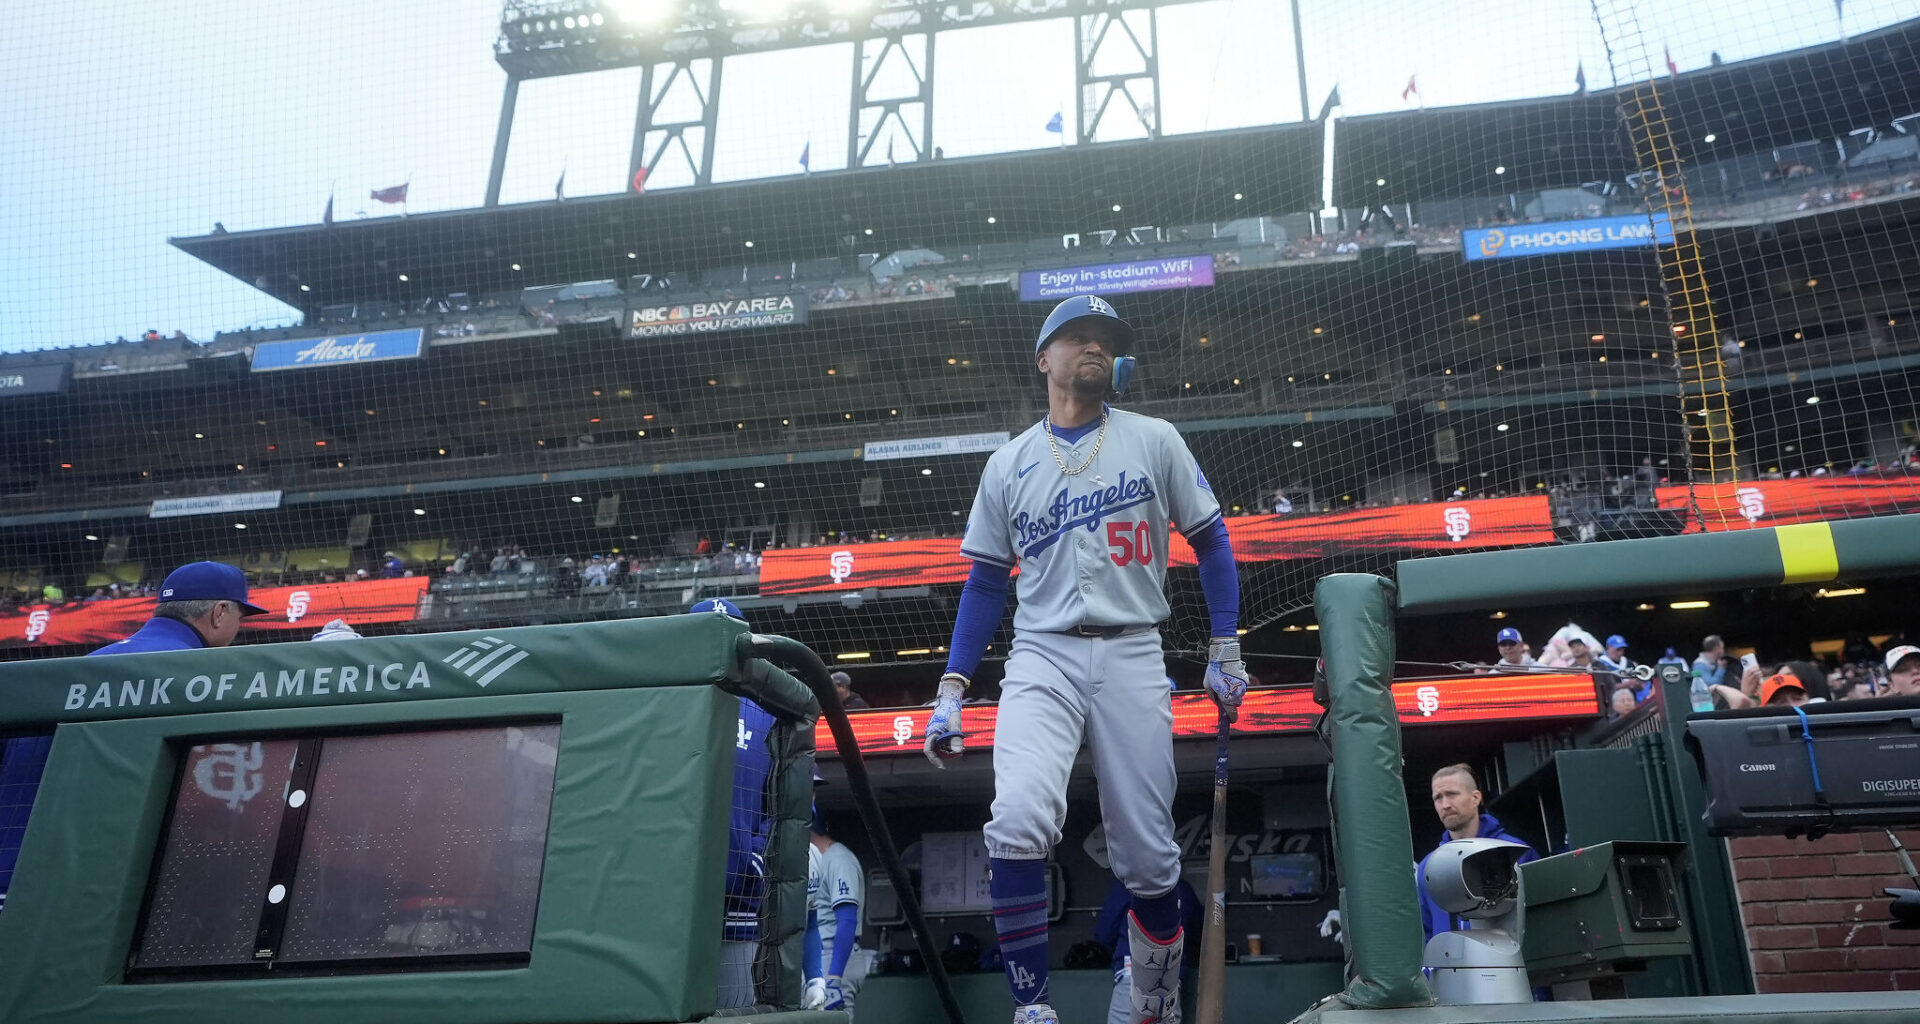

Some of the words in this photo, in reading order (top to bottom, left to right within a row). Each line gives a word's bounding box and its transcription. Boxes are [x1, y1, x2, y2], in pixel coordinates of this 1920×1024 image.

[1510, 228, 1604, 249] PHOONG
[1606, 224, 1652, 241] LAW
[1040, 272, 1078, 287] Enjoy
[1081, 265, 1159, 280] in-stadium
[1161, 260, 1193, 273] WiFi
[1040, 286, 1074, 296] Connect
[632, 307, 668, 323] NBC
[692, 301, 733, 318] BAY
[735, 296, 795, 313] AREA
[1087, 294, 1107, 314] LA
[631, 323, 686, 337] MOVING
[689, 320, 720, 332] YOU
[721, 314, 795, 329] FORWARD
[295, 337, 377, 362] Alaska
[1013, 511, 1050, 548] Los
[1049, 470, 1152, 532] Angeles
[1107, 520, 1153, 567] 50
[712, 599, 728, 614] LA
[64, 677, 175, 711] BANK
[184, 673, 238, 702] OF
[243, 661, 432, 699] AMERICA
[1739, 763, 1776, 773] Canon
[838, 877, 850, 895] LA
[1008, 960, 1036, 990] LA
